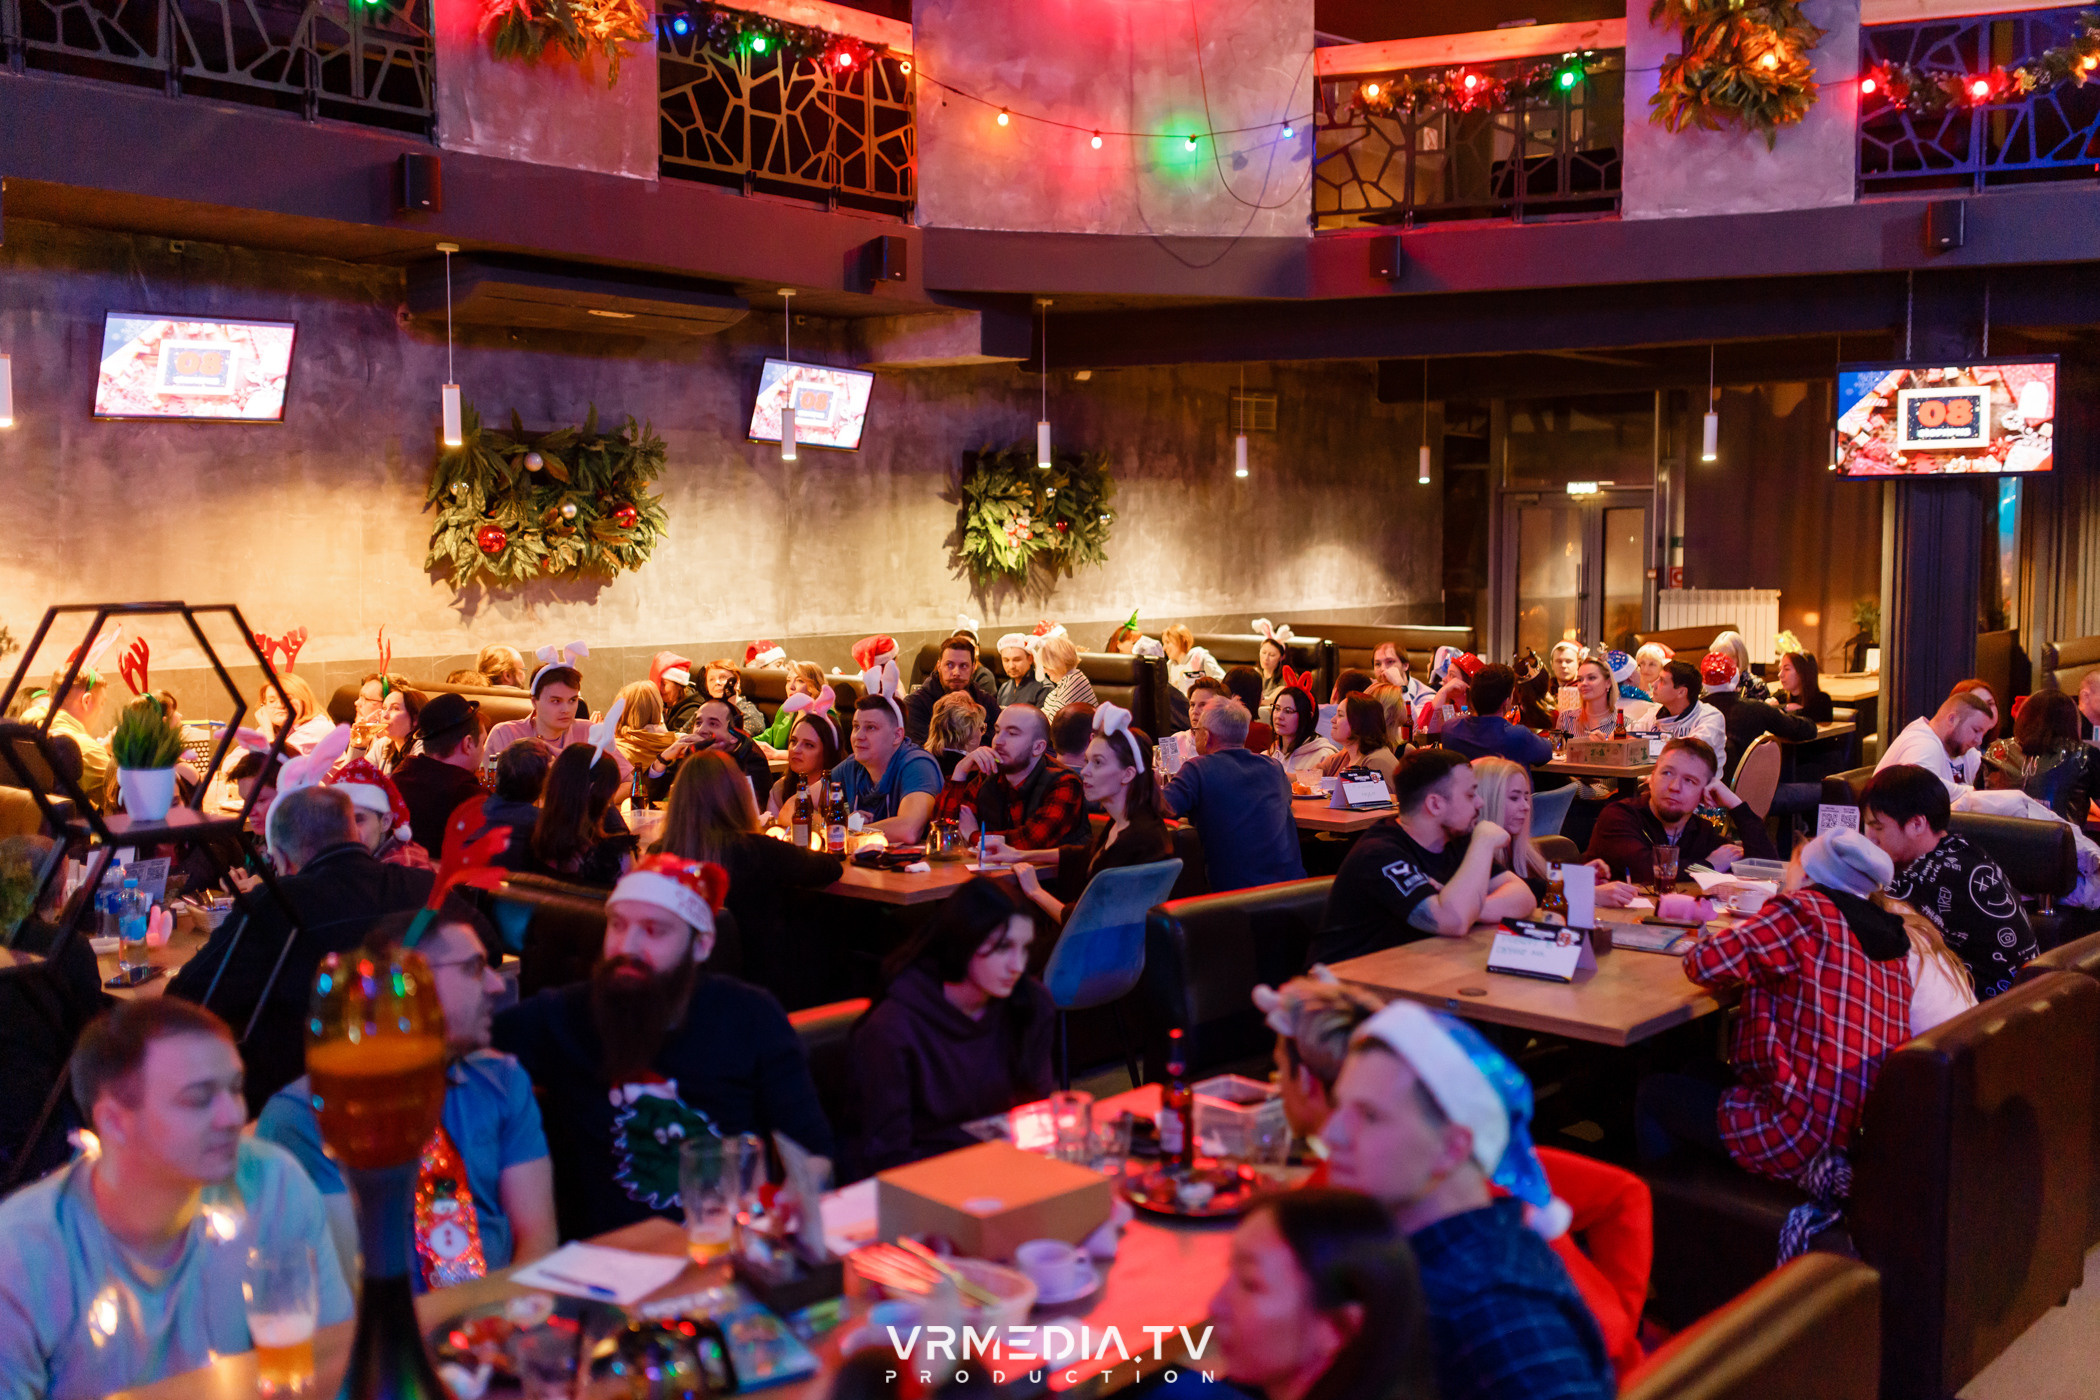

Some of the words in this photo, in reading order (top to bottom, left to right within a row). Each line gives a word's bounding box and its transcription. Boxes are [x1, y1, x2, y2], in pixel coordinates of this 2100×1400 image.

[177, 352, 222, 375] 08
[801, 392, 828, 411] 08
[1918, 399, 1973, 427] 08
[1938, 887, 1952, 914] TIRED
